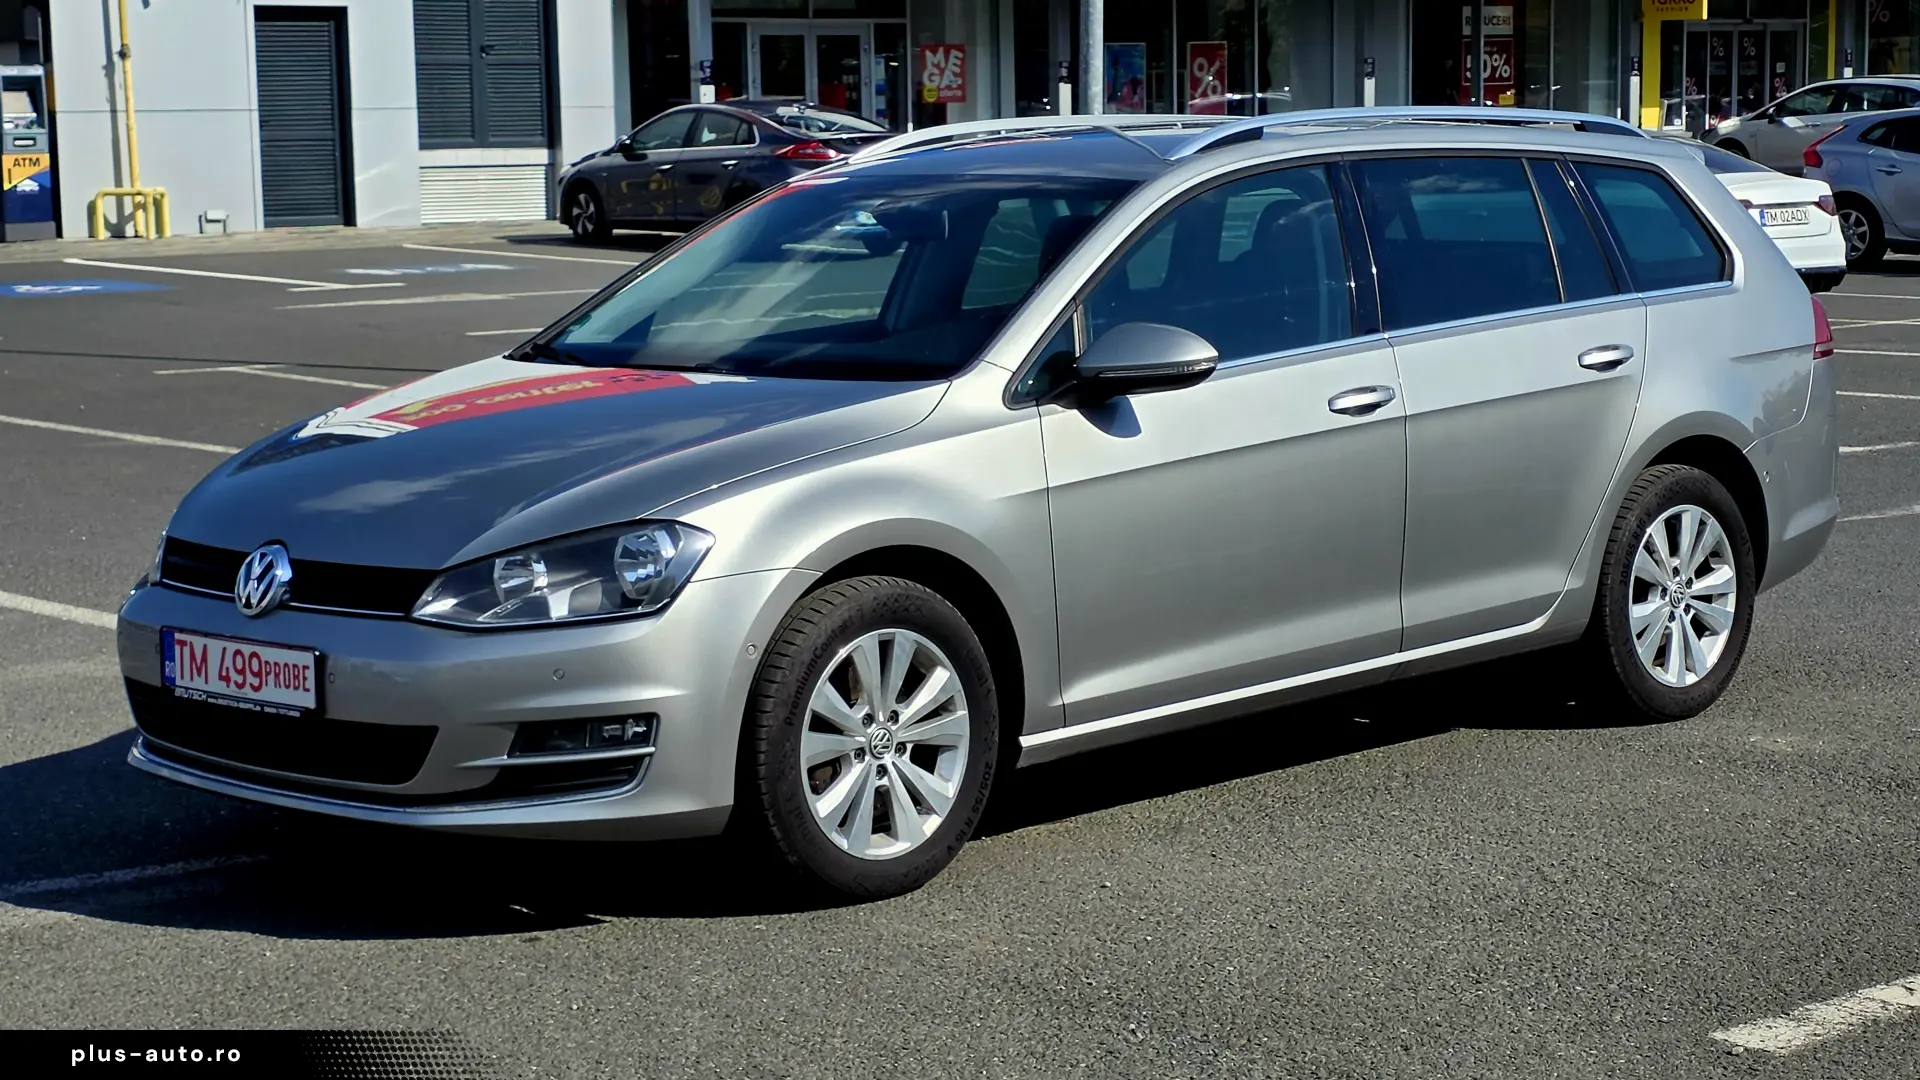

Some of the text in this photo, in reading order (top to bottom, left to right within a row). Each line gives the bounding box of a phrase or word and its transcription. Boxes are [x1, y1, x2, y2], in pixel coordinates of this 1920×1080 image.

[1465, 15, 1511, 26] RUCERI
[13, 156, 41, 168] ATM
[1765, 210, 1779, 223] TM
[175, 638, 311, 693] TM 499 PROBE
